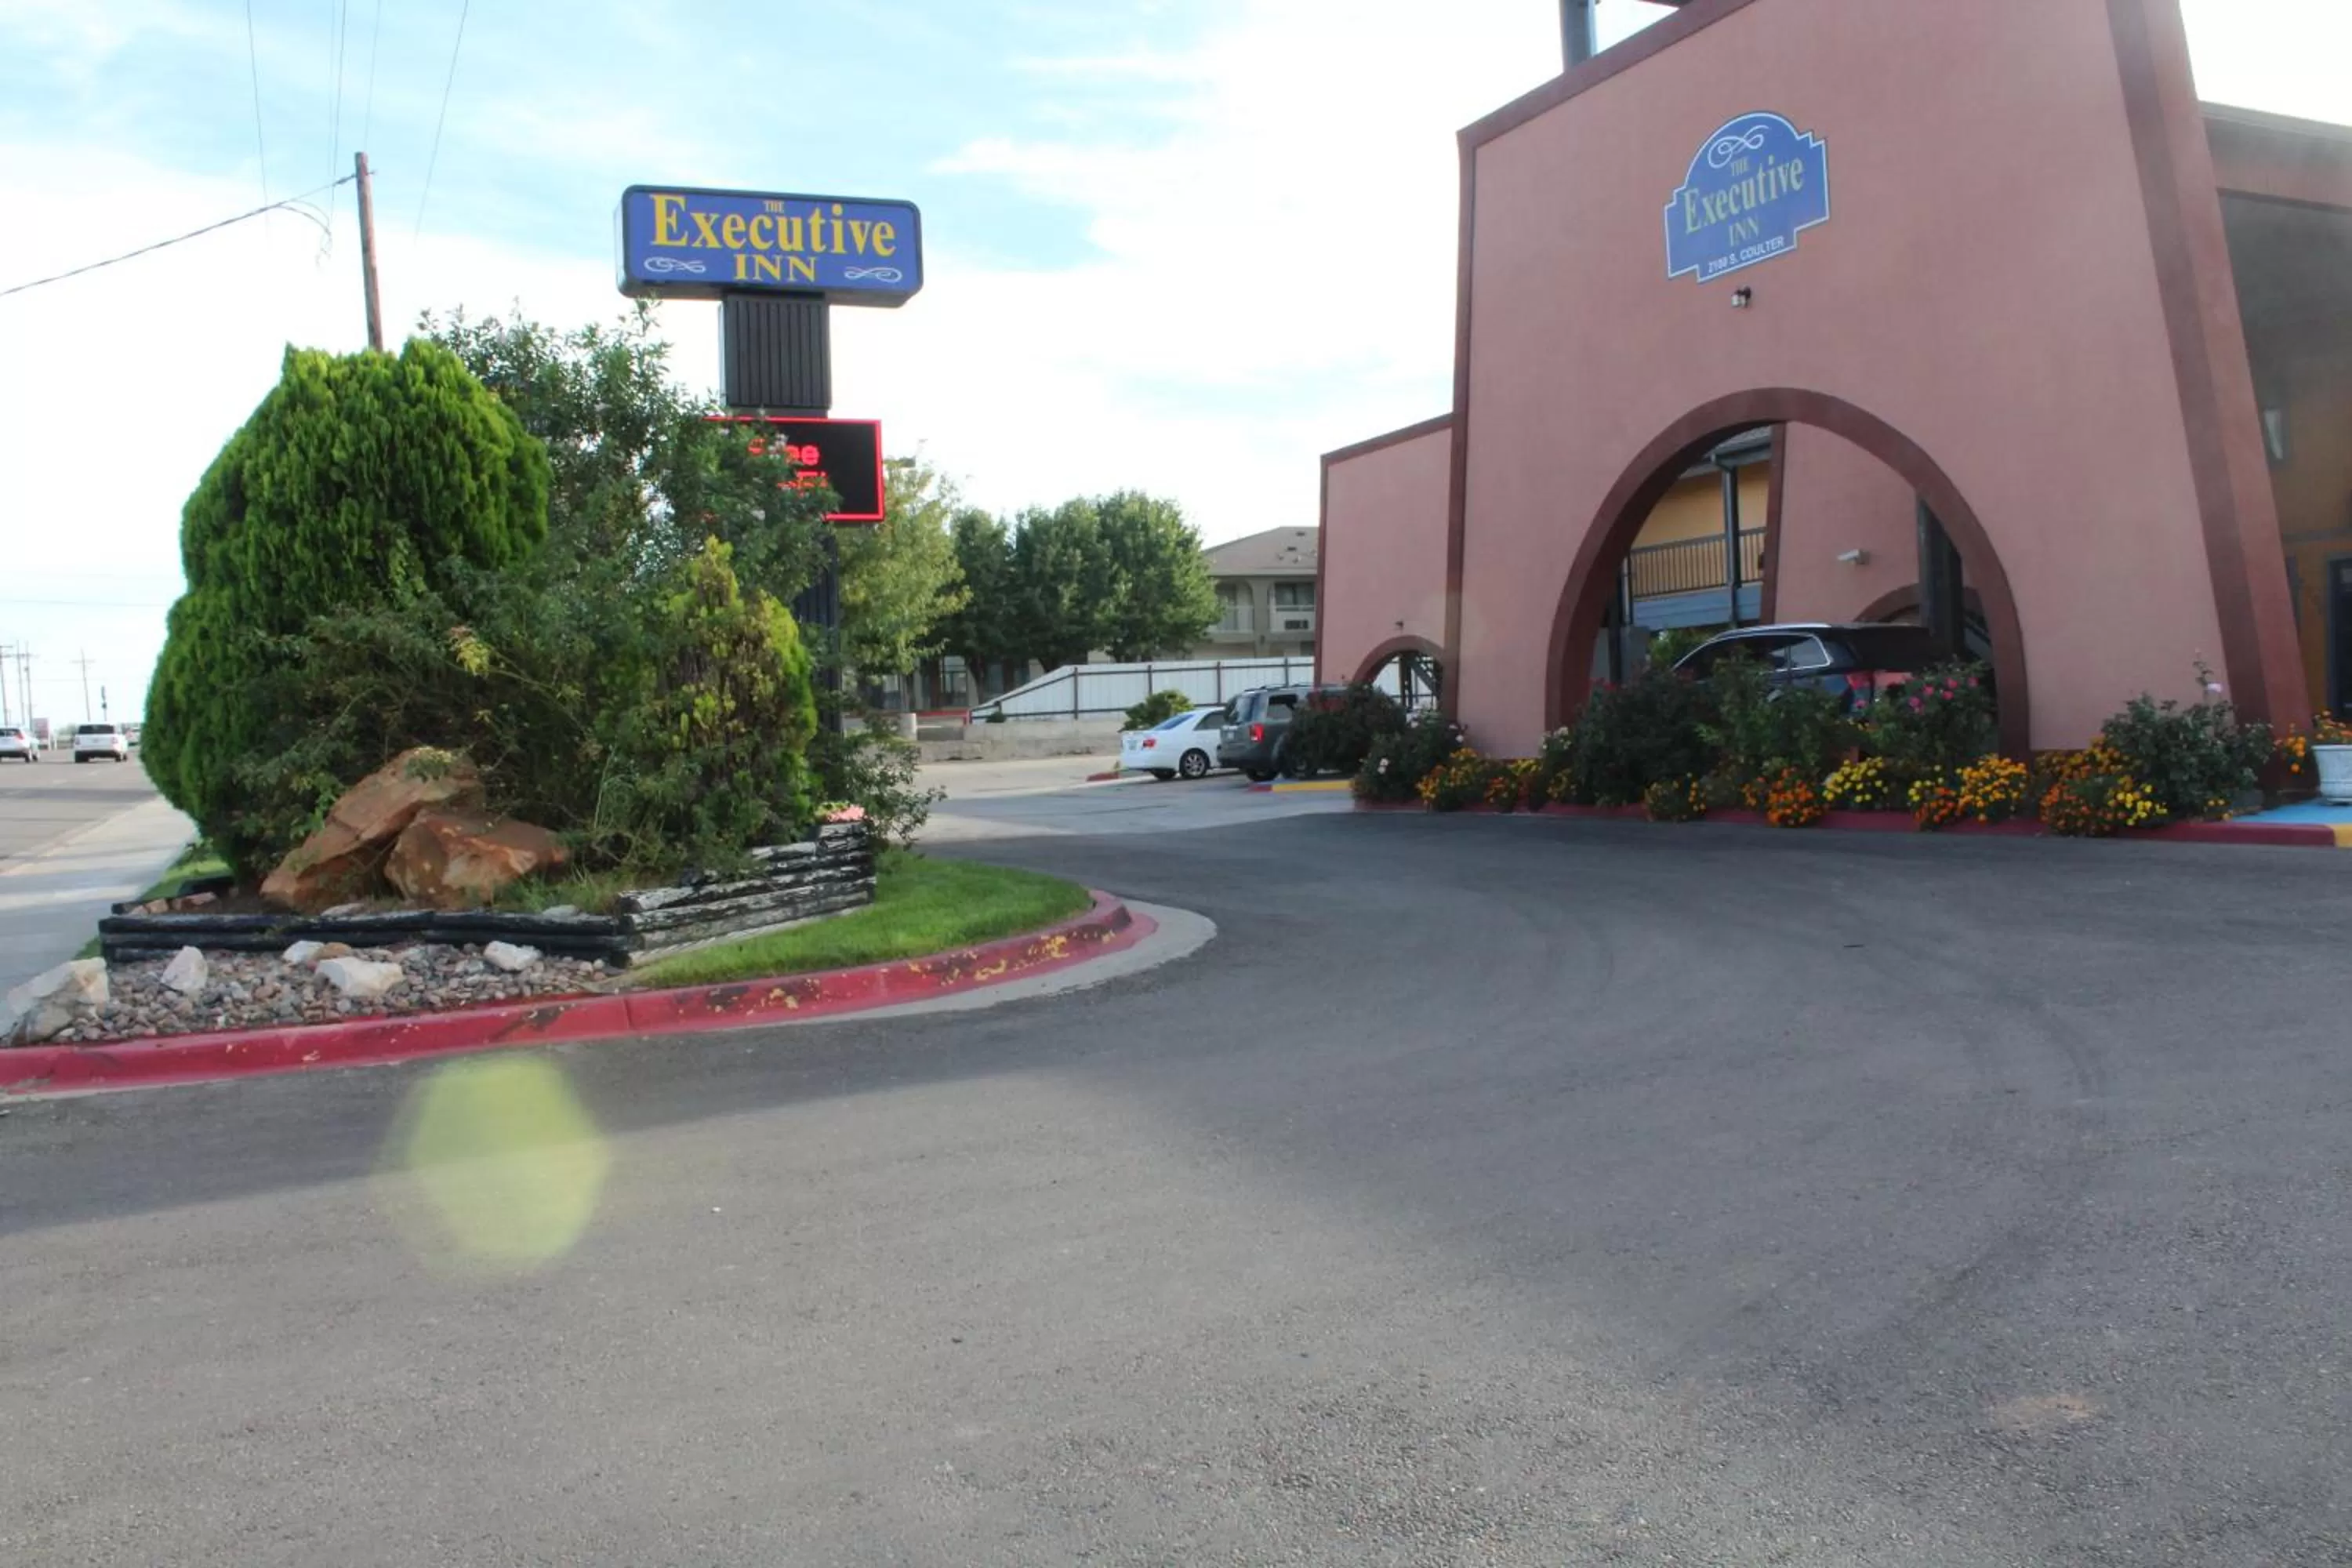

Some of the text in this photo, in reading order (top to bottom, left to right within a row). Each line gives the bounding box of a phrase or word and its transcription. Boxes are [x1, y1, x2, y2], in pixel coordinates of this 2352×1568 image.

[1730, 156, 1751, 176] THE
[763, 199, 784, 213] THE
[1685, 154, 1803, 234] Executive
[649, 194, 896, 256] Executive
[1730, 214, 1759, 247] INN
[1740, 235, 1784, 261] COULTER
[732, 253, 818, 282] INN
